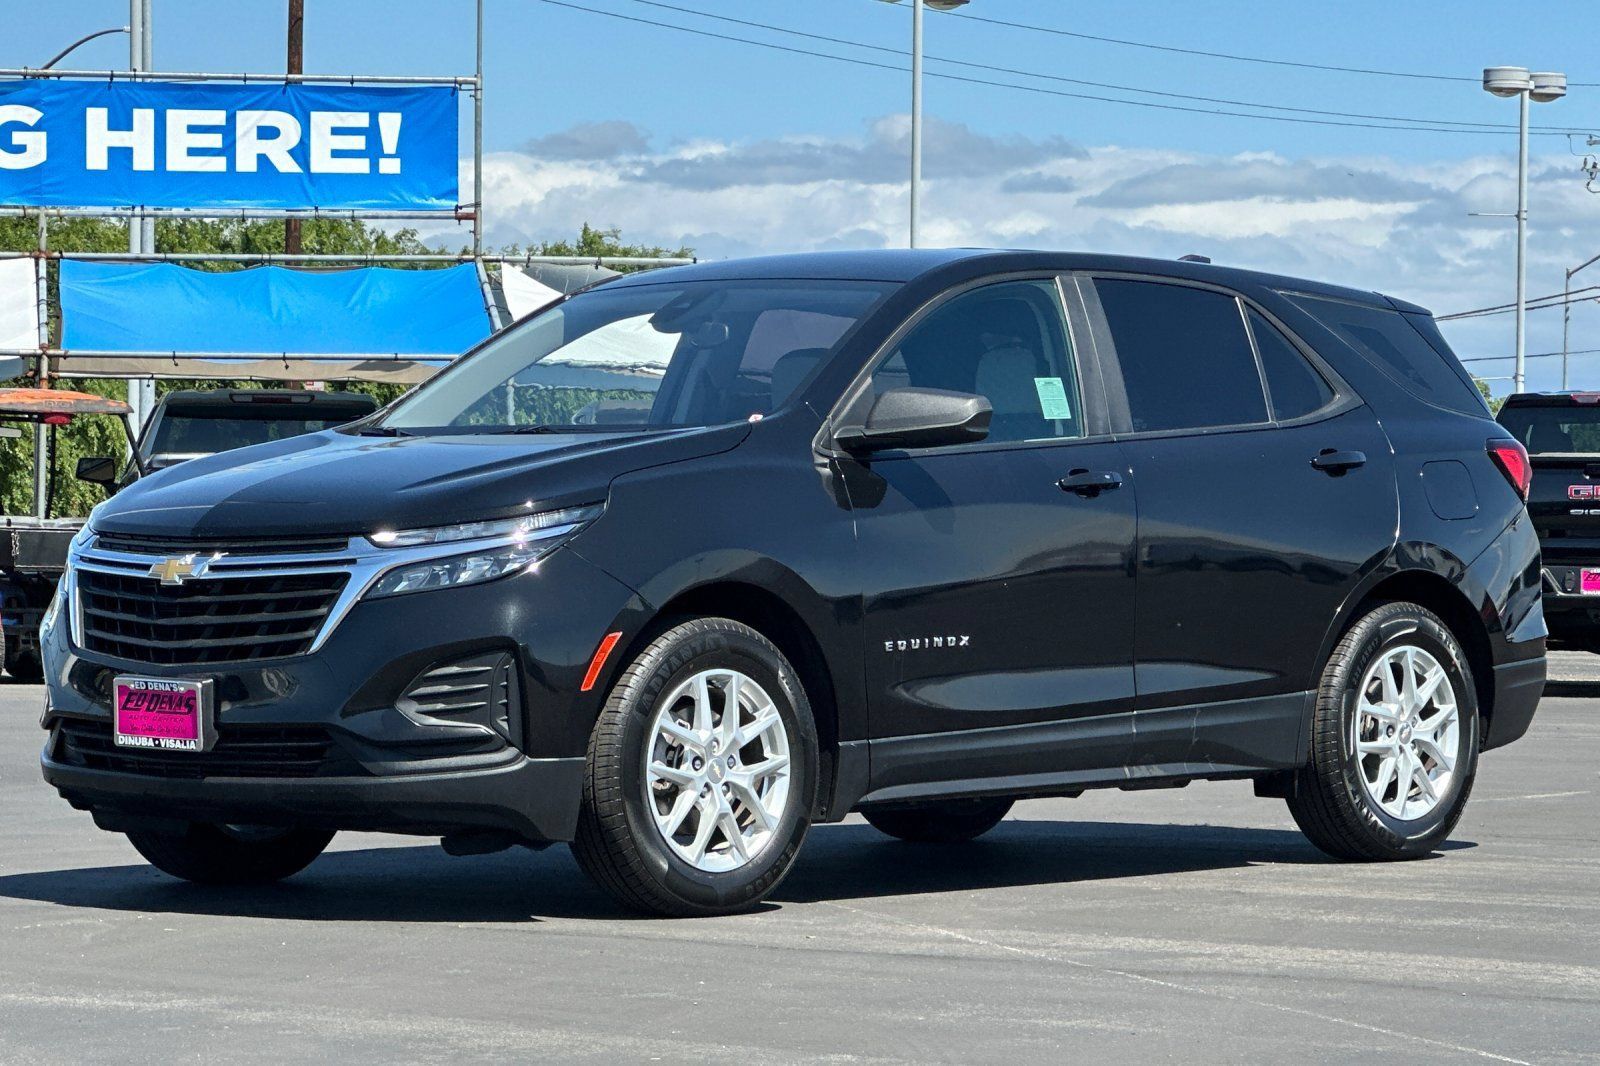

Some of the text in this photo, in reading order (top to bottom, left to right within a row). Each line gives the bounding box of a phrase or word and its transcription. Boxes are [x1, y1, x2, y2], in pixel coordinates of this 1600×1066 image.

[86, 107, 402, 174] HERE!
[884, 635, 970, 652] EQUINOX
[134, 681, 178, 692] ED DENA'S
[121, 691, 147, 711] ED
[118, 735, 196, 750] DINUBA VISALIA
